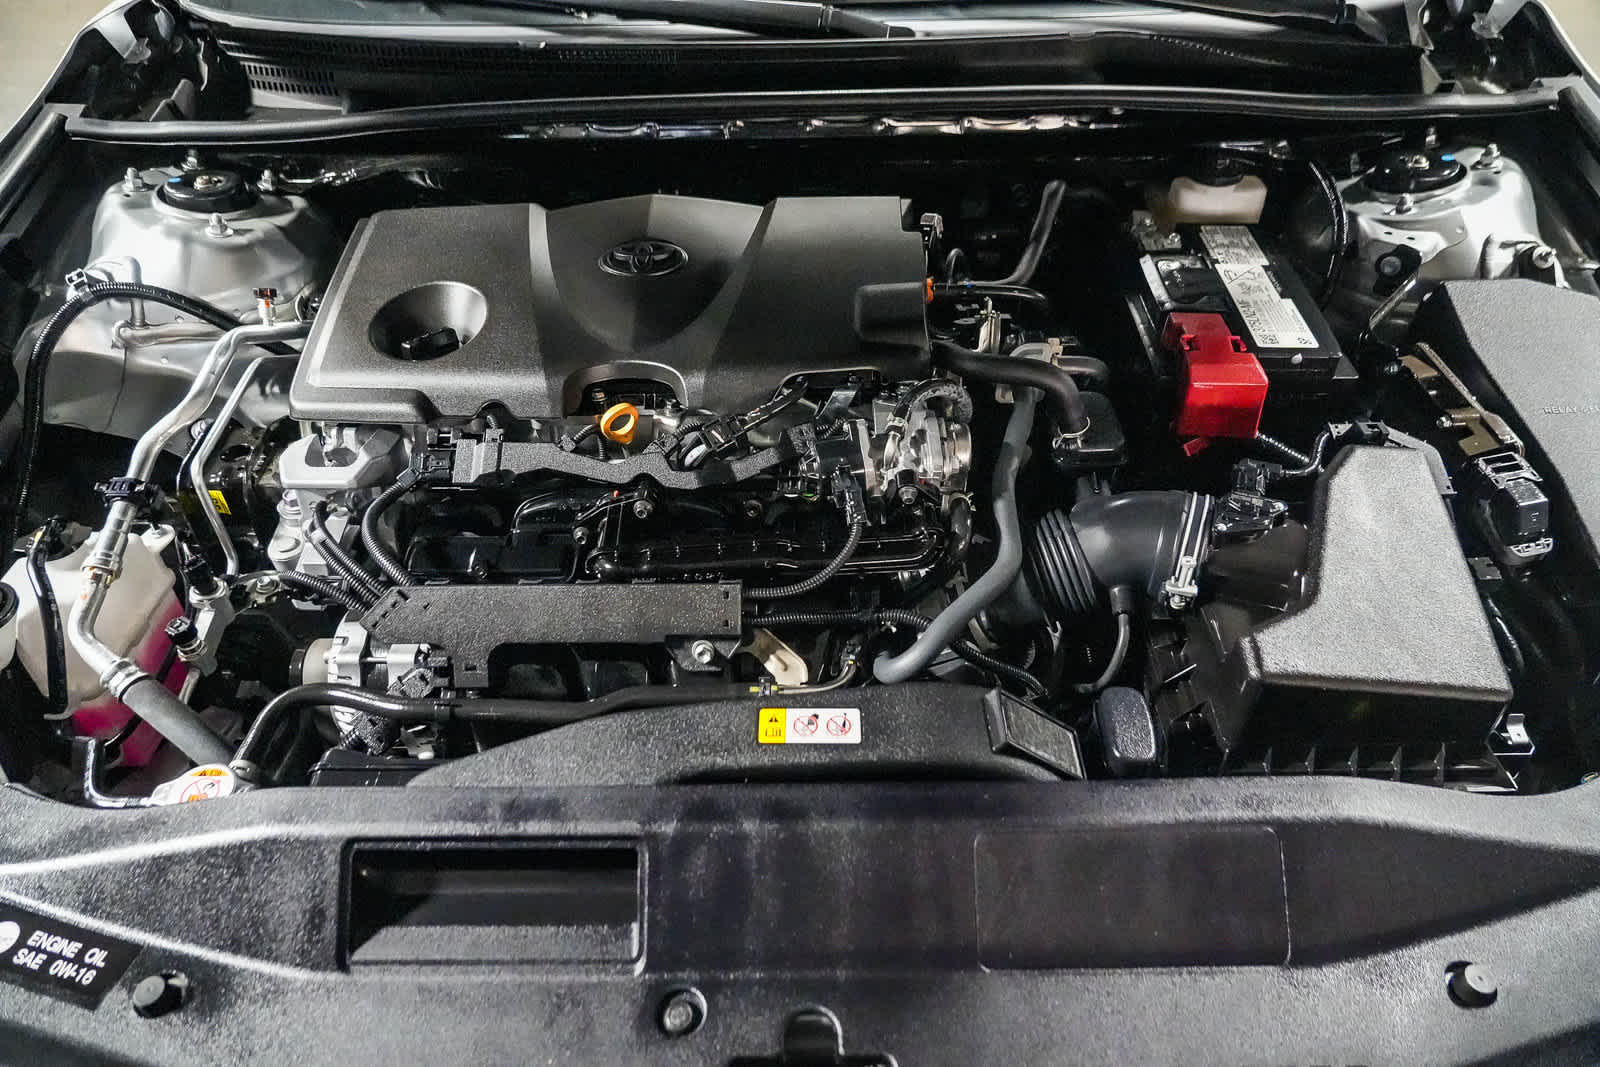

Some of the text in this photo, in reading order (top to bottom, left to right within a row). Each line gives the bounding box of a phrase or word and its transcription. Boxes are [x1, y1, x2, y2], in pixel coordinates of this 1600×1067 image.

[13, 948, 97, 985] SAE 0W-16
[27, 929, 83, 958] ENGINE
[84, 947, 108, 968] OIL
